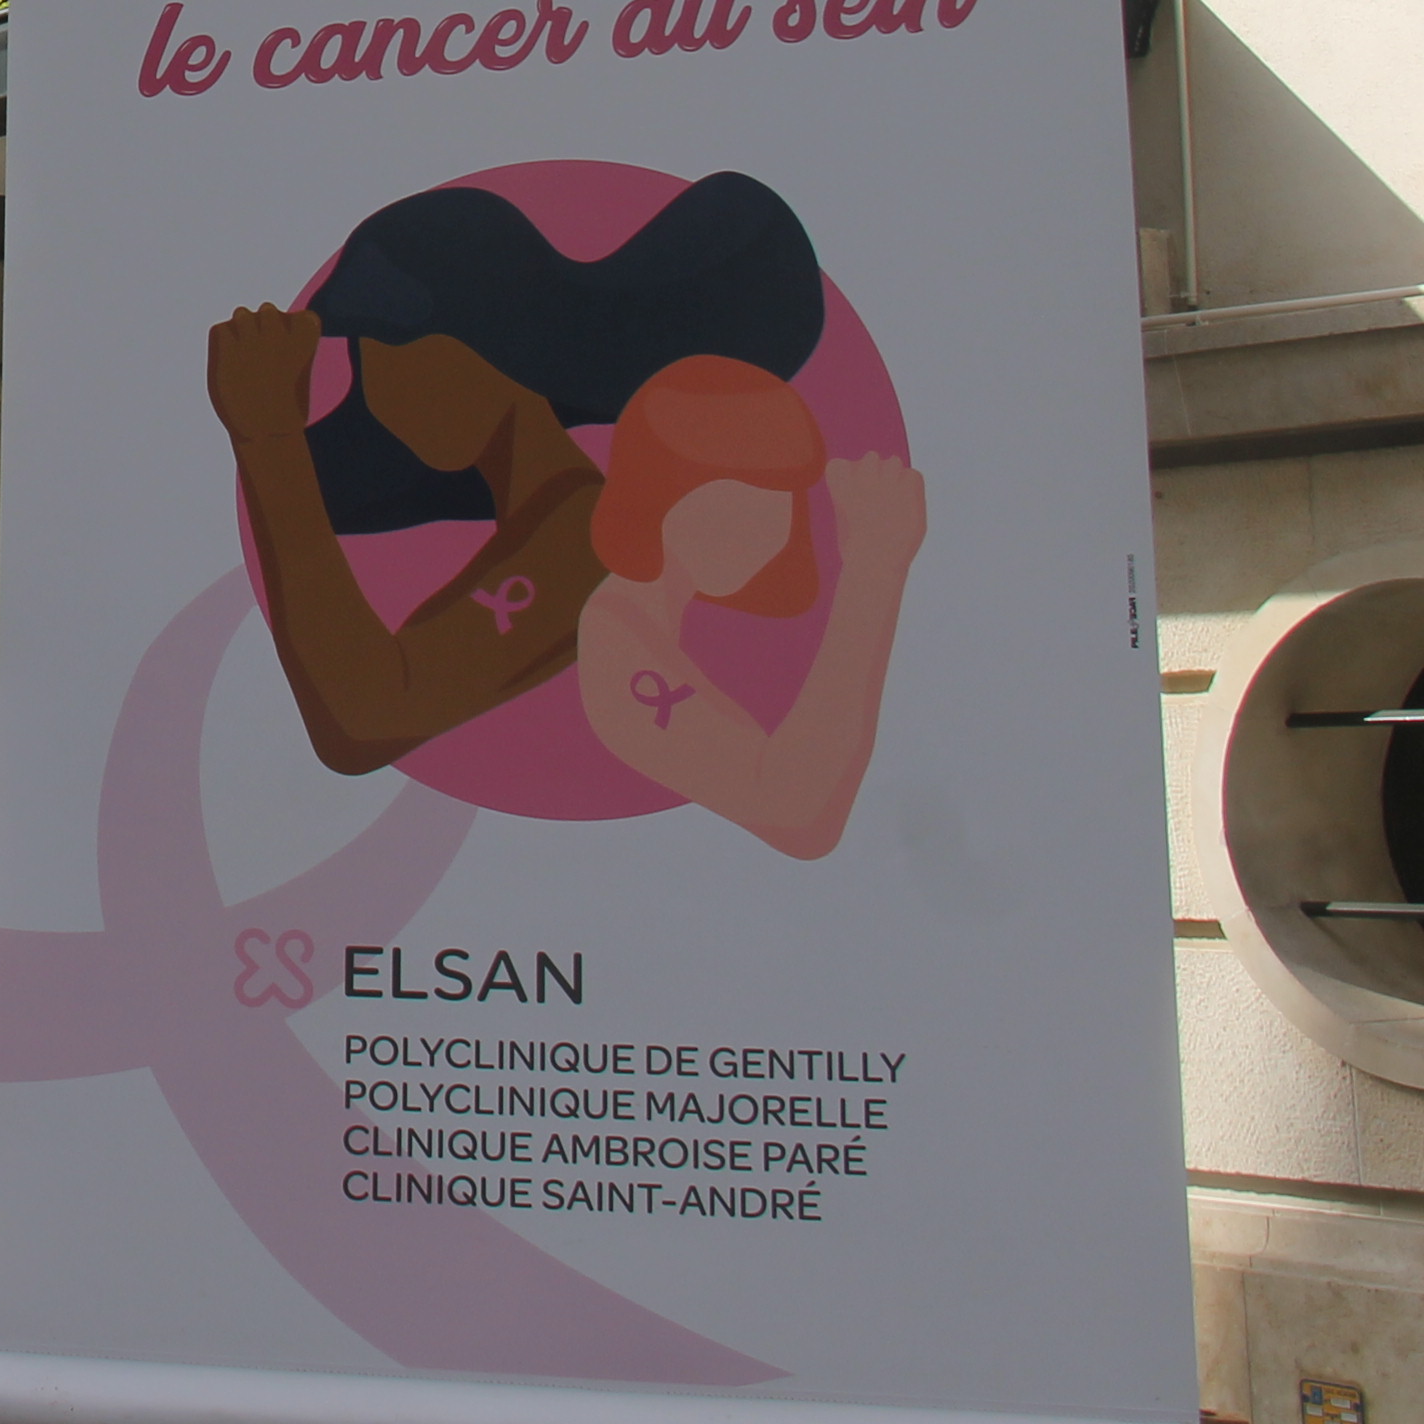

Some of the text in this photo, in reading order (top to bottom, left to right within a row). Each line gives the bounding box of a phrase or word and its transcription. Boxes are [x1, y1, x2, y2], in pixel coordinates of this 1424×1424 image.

[137, 1, 233, 99] le
[343, 945, 584, 1007] ELSAN
[344, 1034, 907, 1085] POLYCLINIQUE DE GENTILLY
[343, 1079, 890, 1131] POLYCLINIQUE MAJORELLE
[342, 1125, 869, 1178] CLINIQUE AMBROISE PARÉ
[341, 1170, 823, 1223] CLINIQUE SAINT-ANDRÉ
